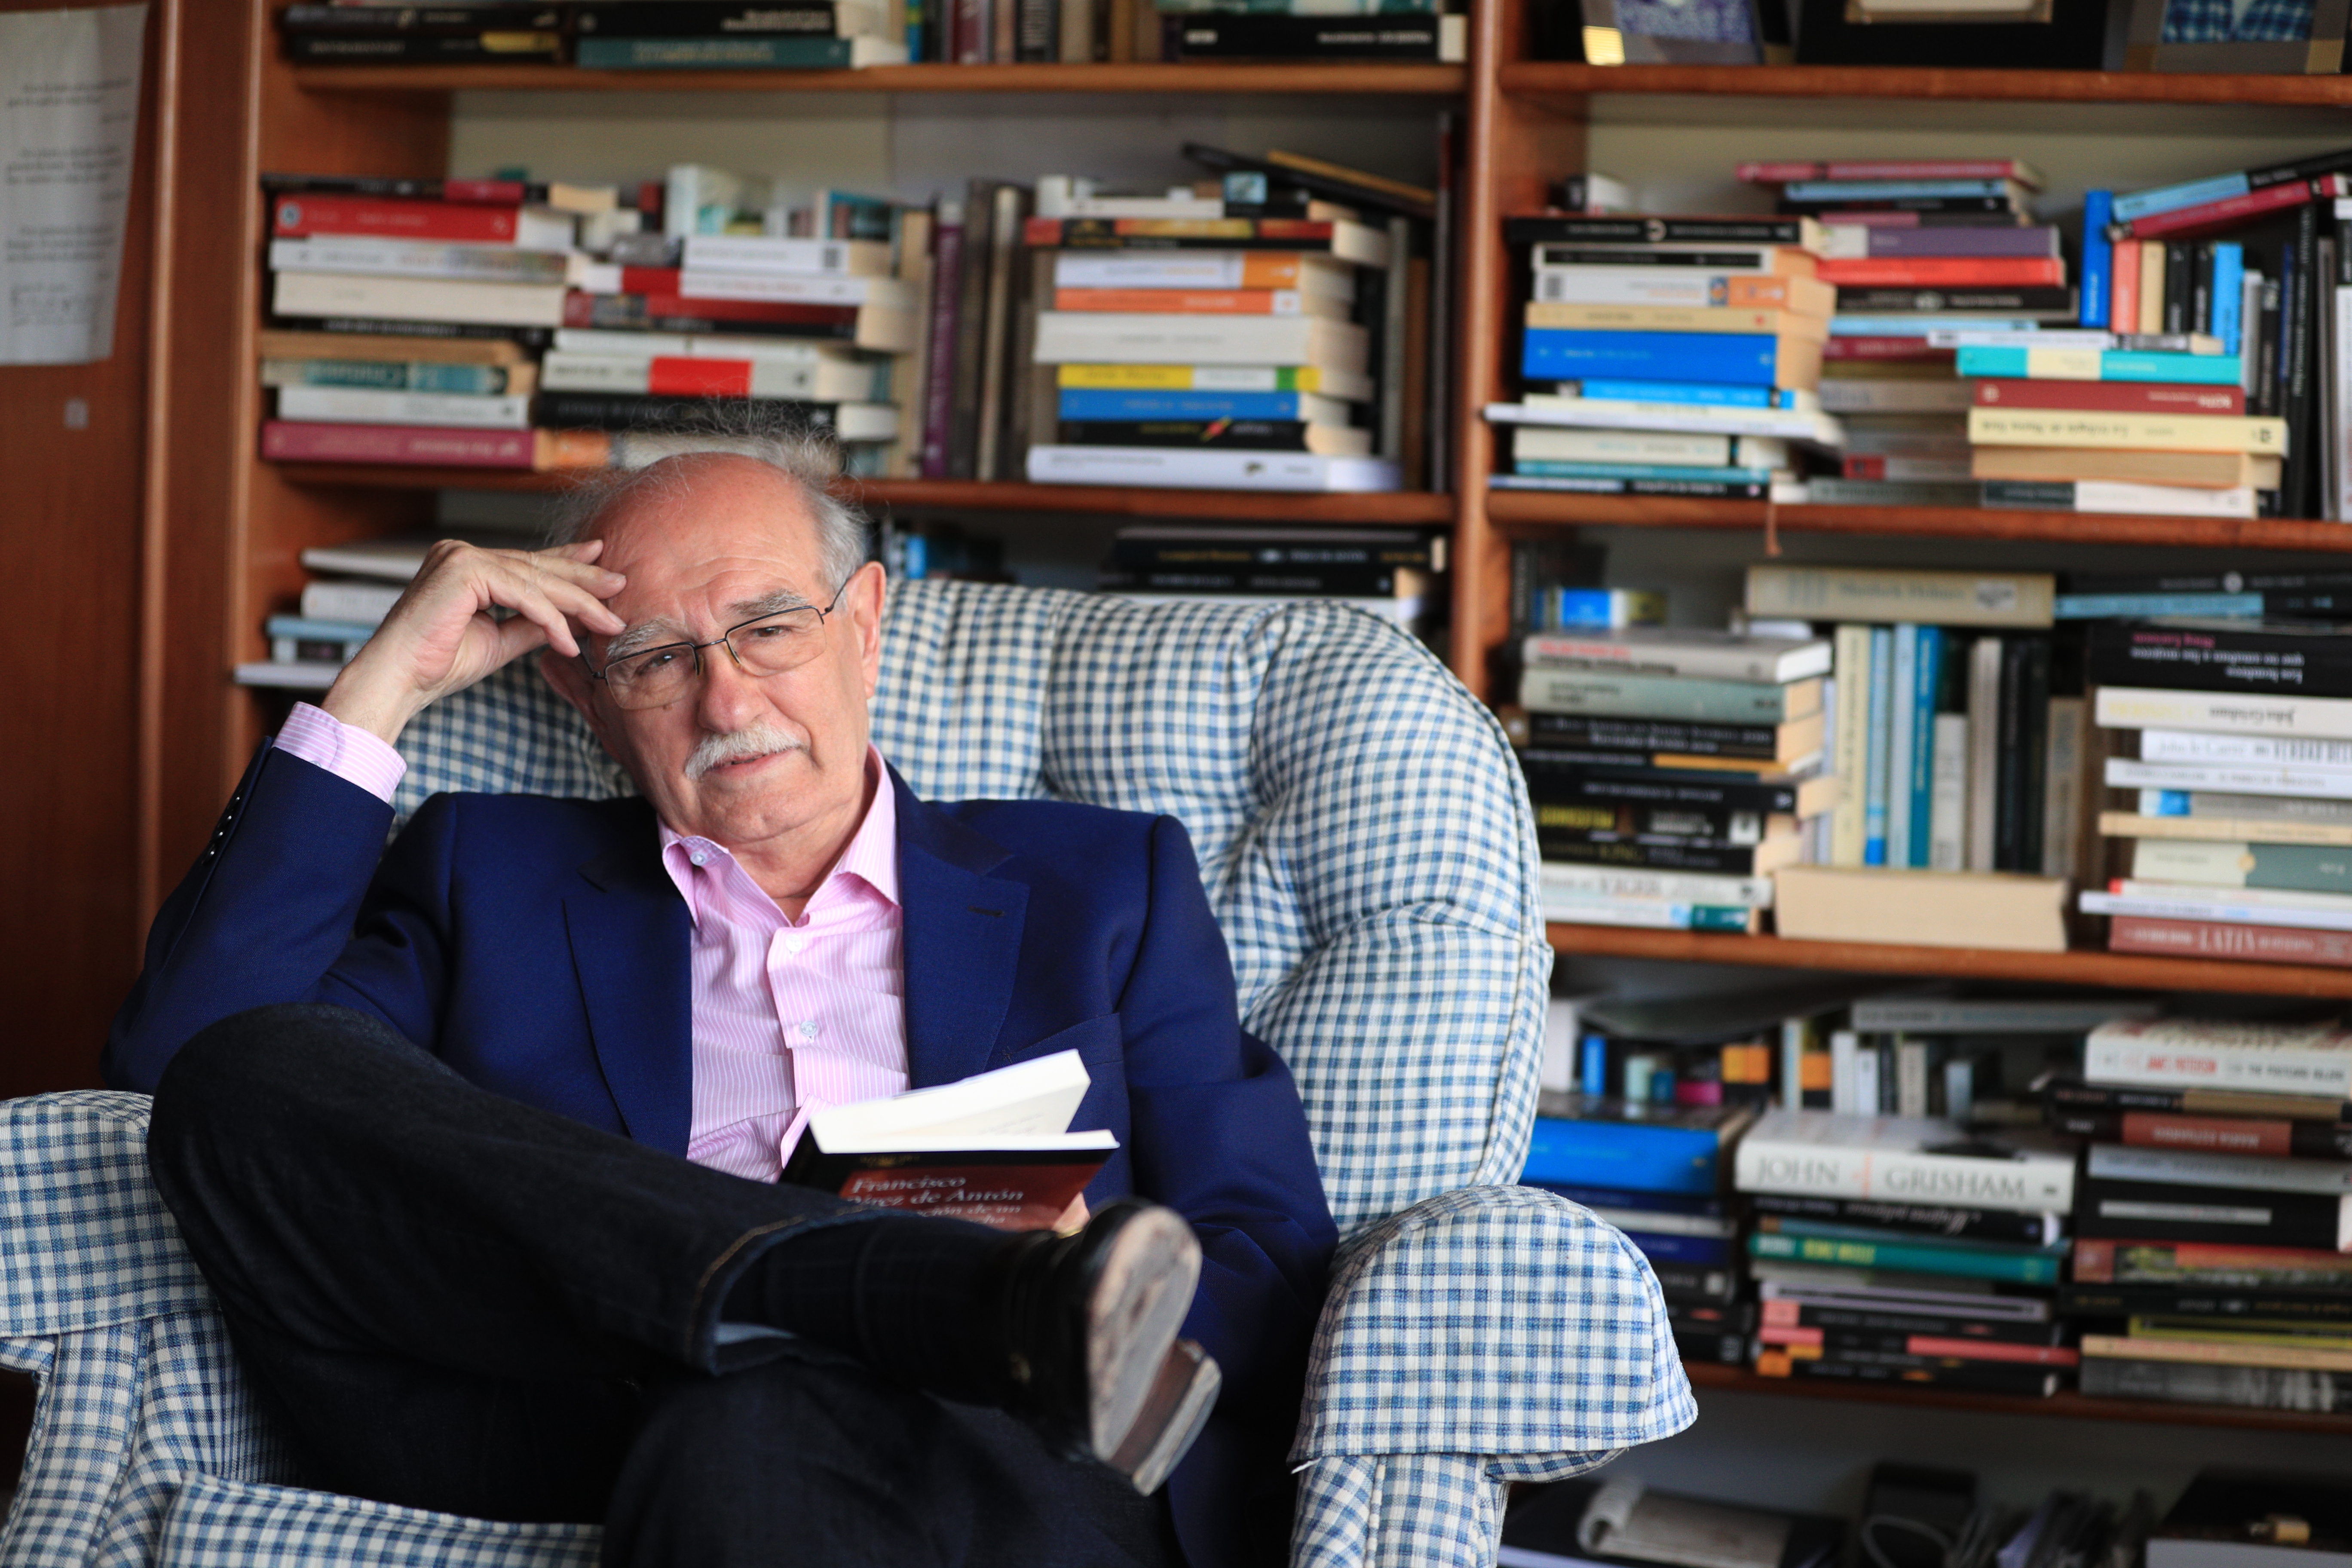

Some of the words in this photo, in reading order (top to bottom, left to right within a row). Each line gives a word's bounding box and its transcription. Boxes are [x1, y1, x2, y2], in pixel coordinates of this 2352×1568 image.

[851, 1175, 967, 1194] Francisco
[1758, 1156, 1841, 1185] JOHN
[1884, 1166, 2026, 1199] GRISHAM
[910, 1189, 942, 1204] de
[946, 1188, 1024, 1202] Antón
[967, 1203, 991, 1214] de
